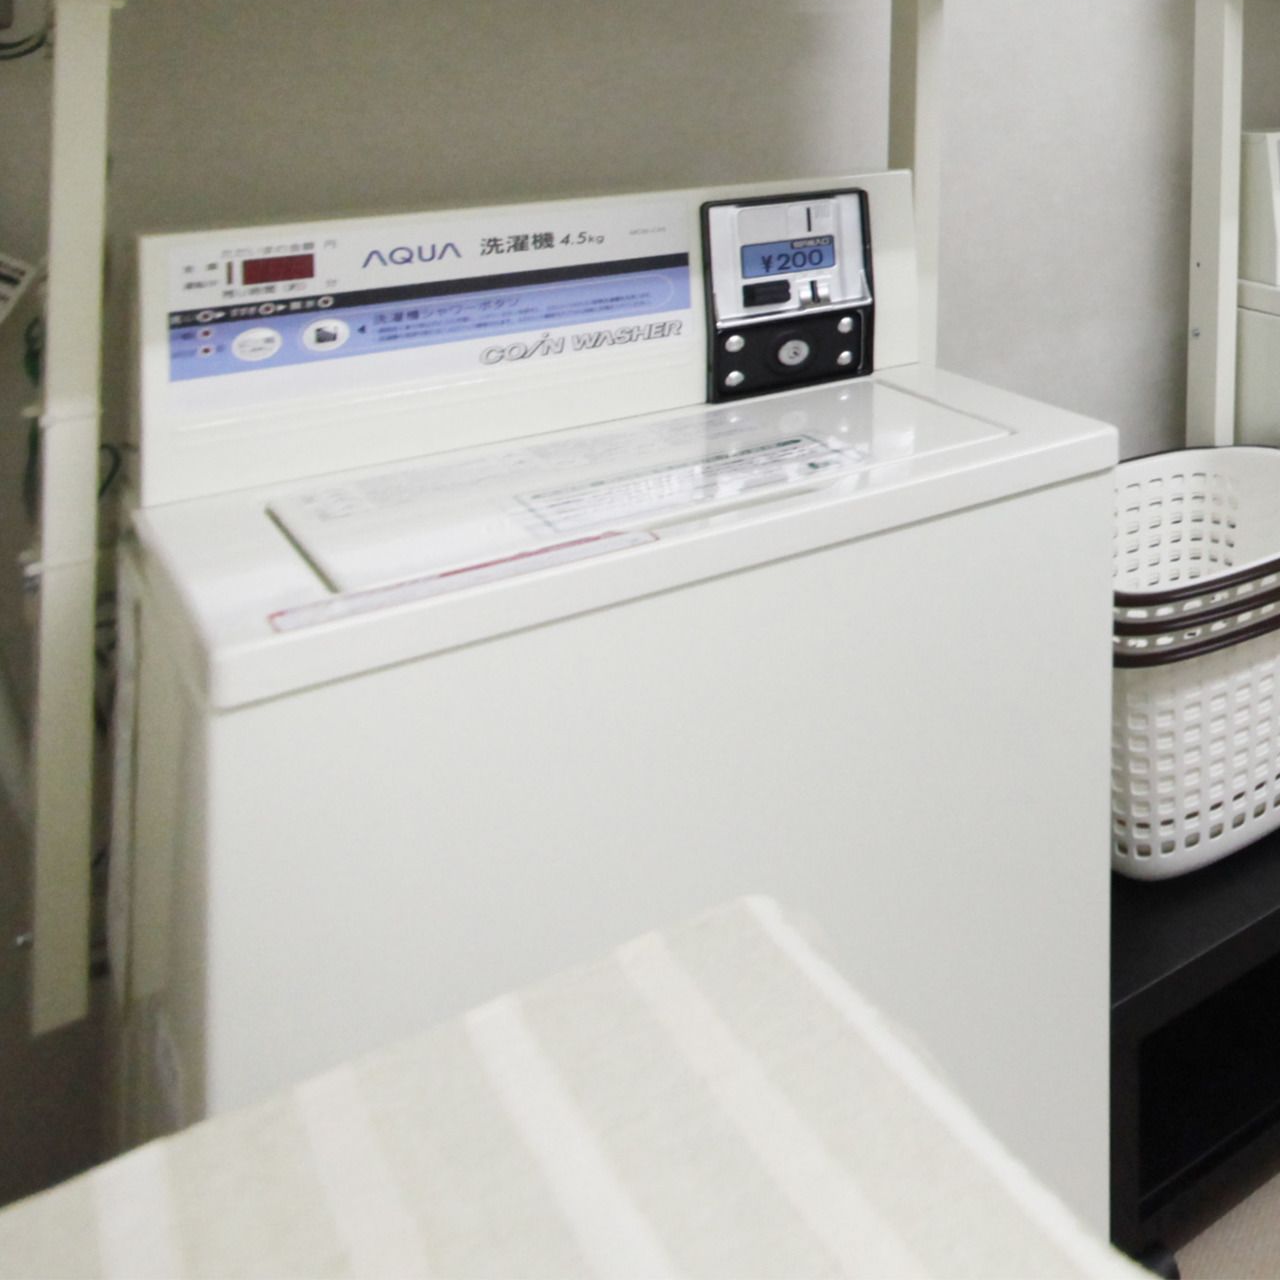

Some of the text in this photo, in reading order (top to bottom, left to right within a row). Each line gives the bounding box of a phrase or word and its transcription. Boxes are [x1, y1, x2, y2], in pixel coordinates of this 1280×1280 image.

[362, 241, 462, 269] AQUA
[480, 231, 555, 256] 洗濯機
[558, 230, 605, 246] 4.5kg
[761, 249, 825, 274] ¥200
[572, 320, 683, 353] WASHER
